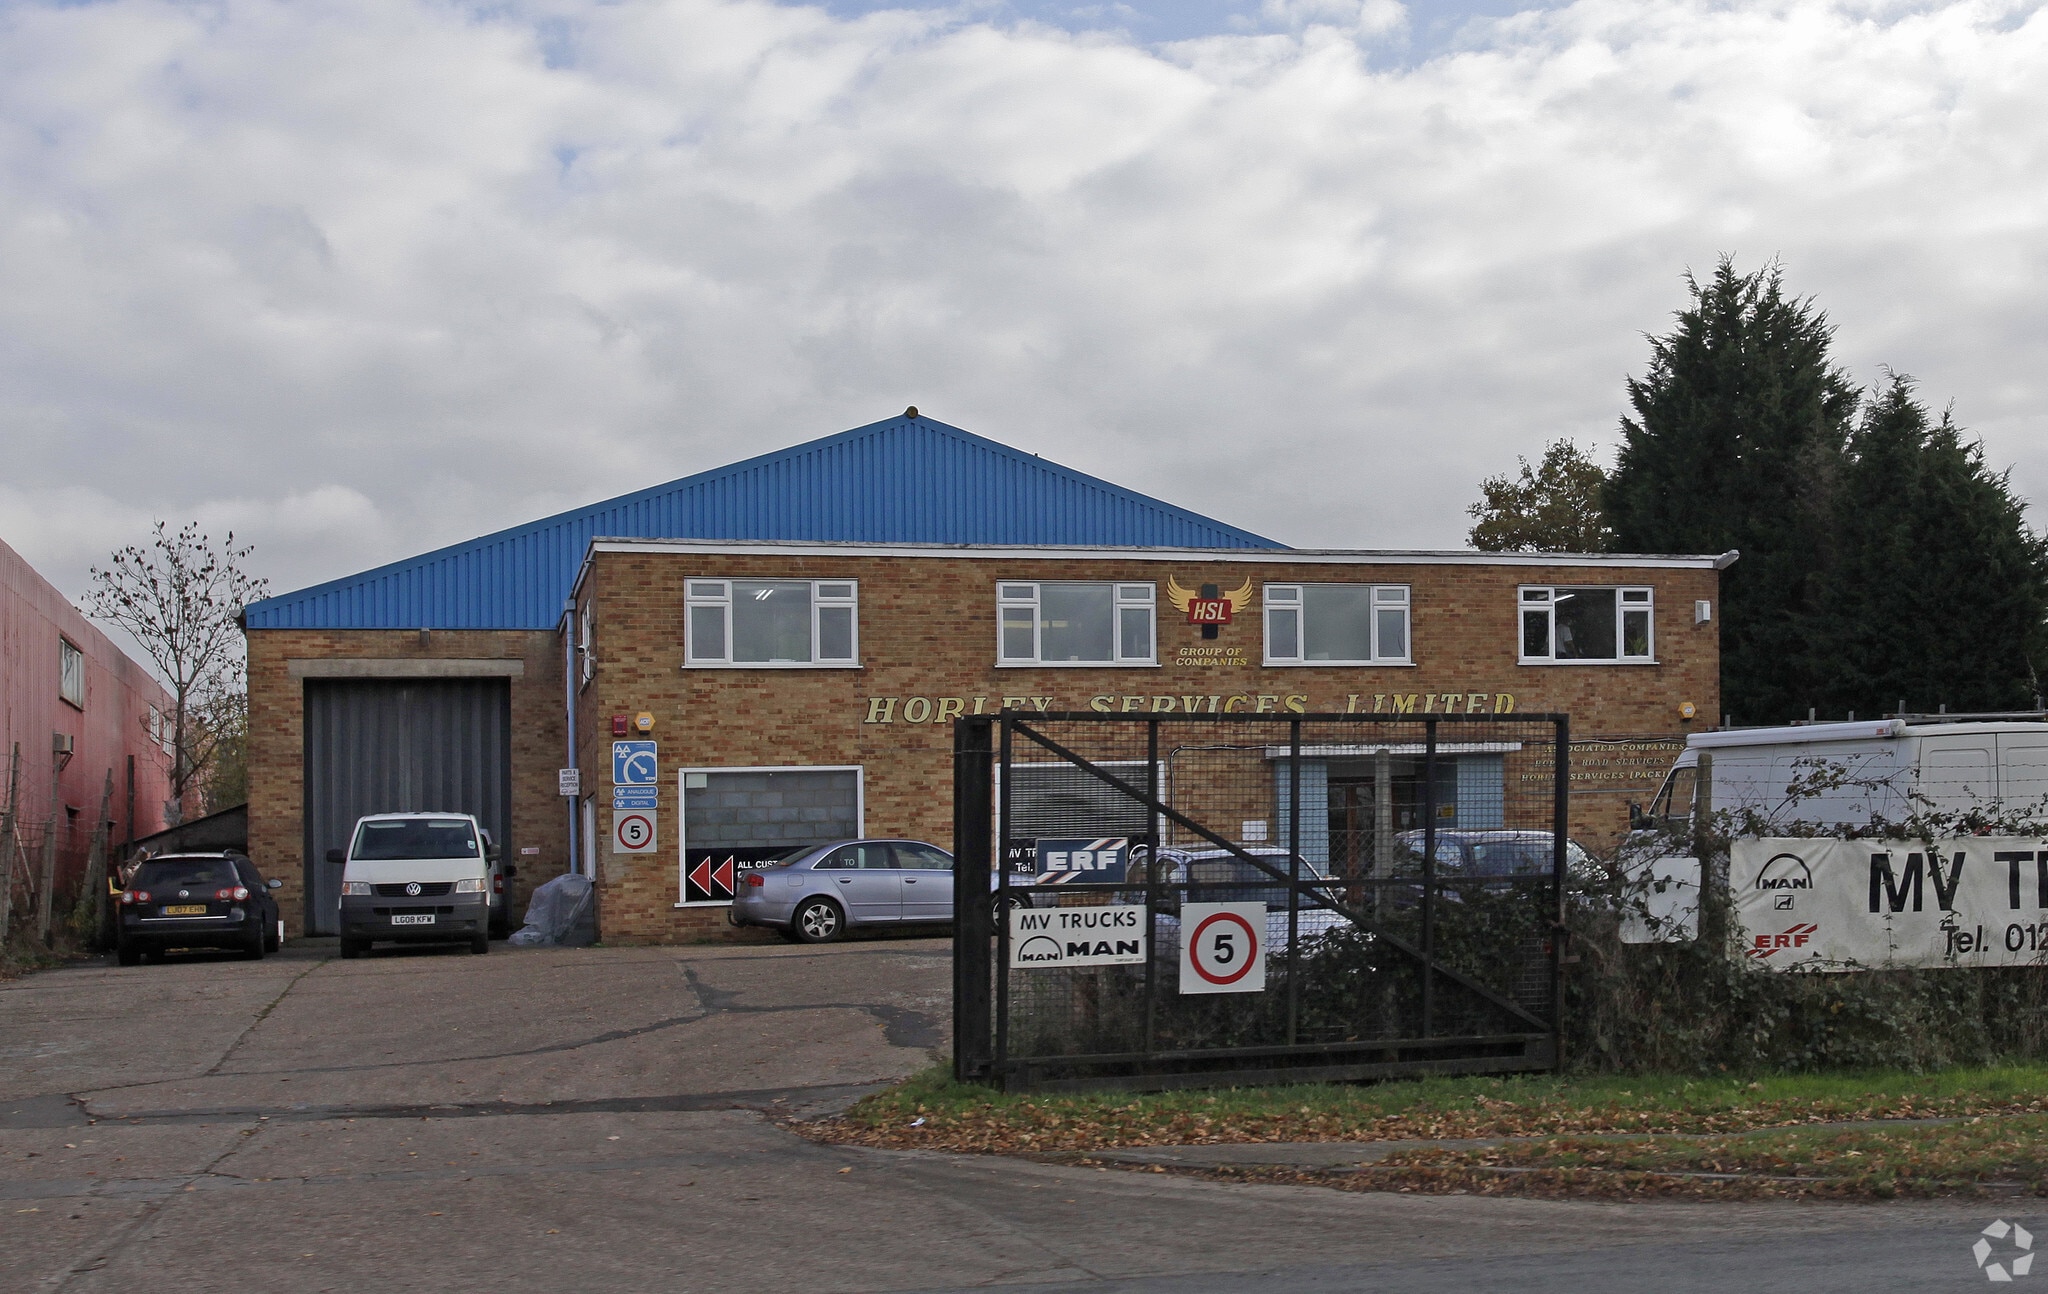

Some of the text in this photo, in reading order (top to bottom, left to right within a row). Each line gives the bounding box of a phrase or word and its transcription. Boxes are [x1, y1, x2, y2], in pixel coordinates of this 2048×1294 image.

[1193, 601, 1226, 620] HSL
[1179, 647, 1242, 656] GROUP OF
[1175, 657, 1248, 666] COMPANIES
[1544, 743, 1685, 752] AOCIATED COMPANIES
[1615, 757, 1665, 765] SERVICES
[630, 825, 641, 839] 5
[737, 861, 753, 869] ALL
[1046, 851, 1118, 871] ERF
[1761, 878, 1807, 889] MAN
[1869, 851, 1966, 913] MV
[394, 916, 415, 924] LG08
[1020, 911, 1137, 930] MV TRUCKS
[1755, 935, 1809, 948] ERF
[1940, 924, 1989, 956] Tel.
[1066, 940, 1139, 957] MAN
[1214, 934, 1234, 964] 5
[1022, 953, 1059, 962] MAN
